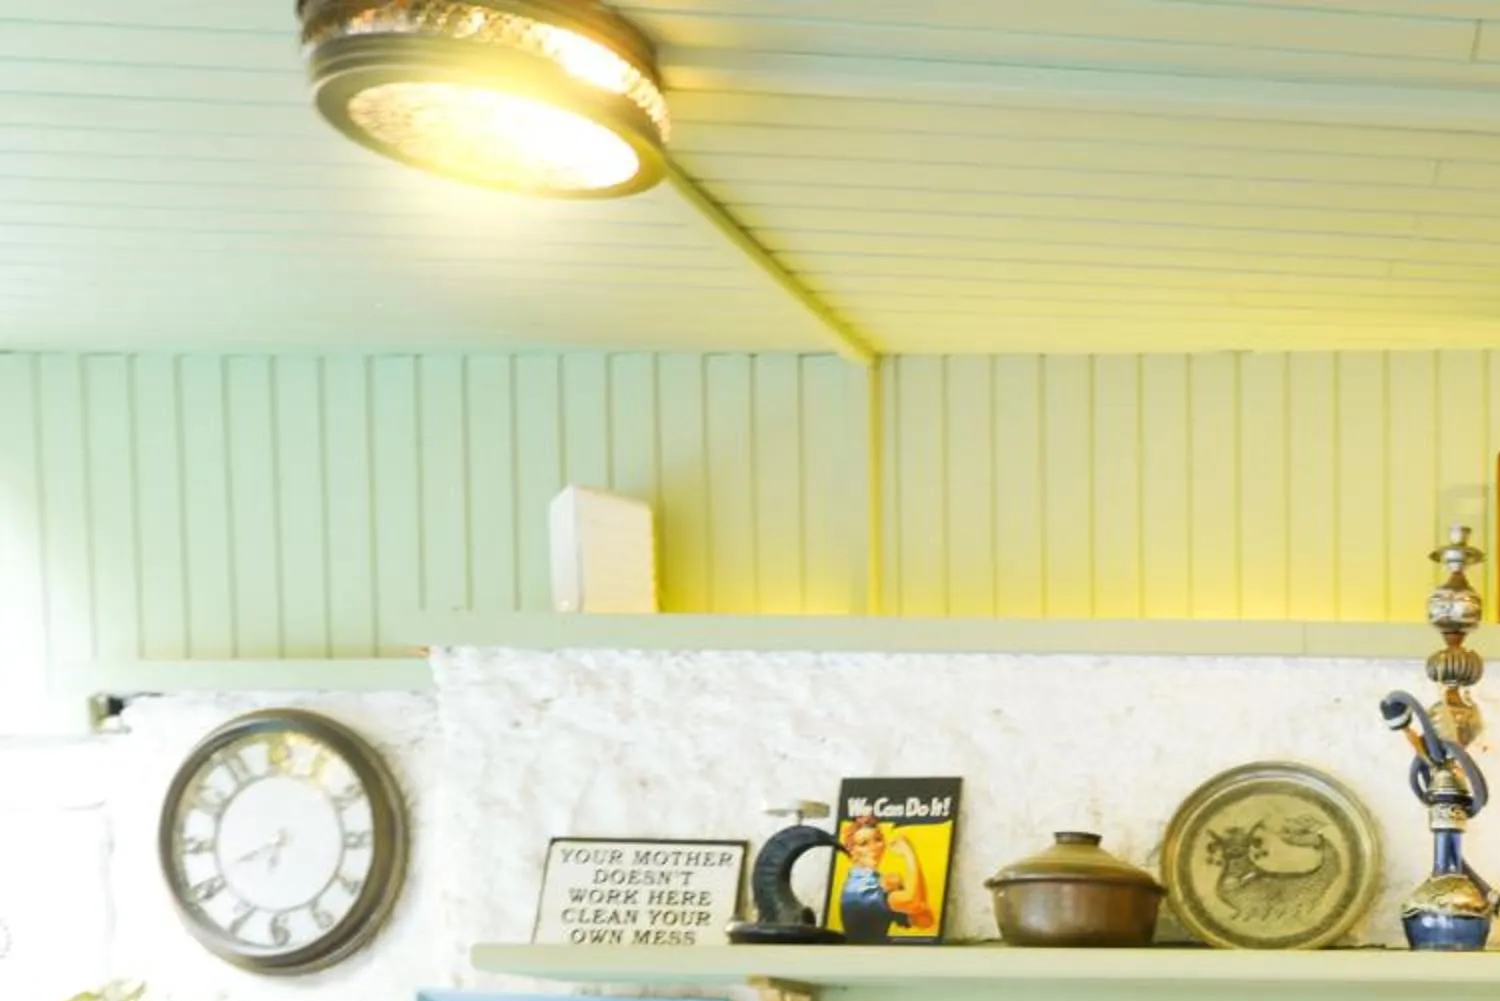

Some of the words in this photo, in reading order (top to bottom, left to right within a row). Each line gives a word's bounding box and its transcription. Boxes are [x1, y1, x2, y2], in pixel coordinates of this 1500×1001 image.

[847, 797, 873, 817] We
[874, 796, 904, 817] Can
[905, 796, 929, 817] Do
[930, 796, 952, 817] It!
[560, 849, 623, 865] YOUR
[632, 850, 734, 867] MOTHER
[593, 868, 694, 885] DOESN'T
[568, 888, 639, 905] WORK
[647, 889, 712, 906] HERE
[560, 908, 639, 925] CLEAN
[648, 909, 712, 926] YOUR
[570, 928, 624, 945] OWN
[631, 929, 697, 945] MESS
